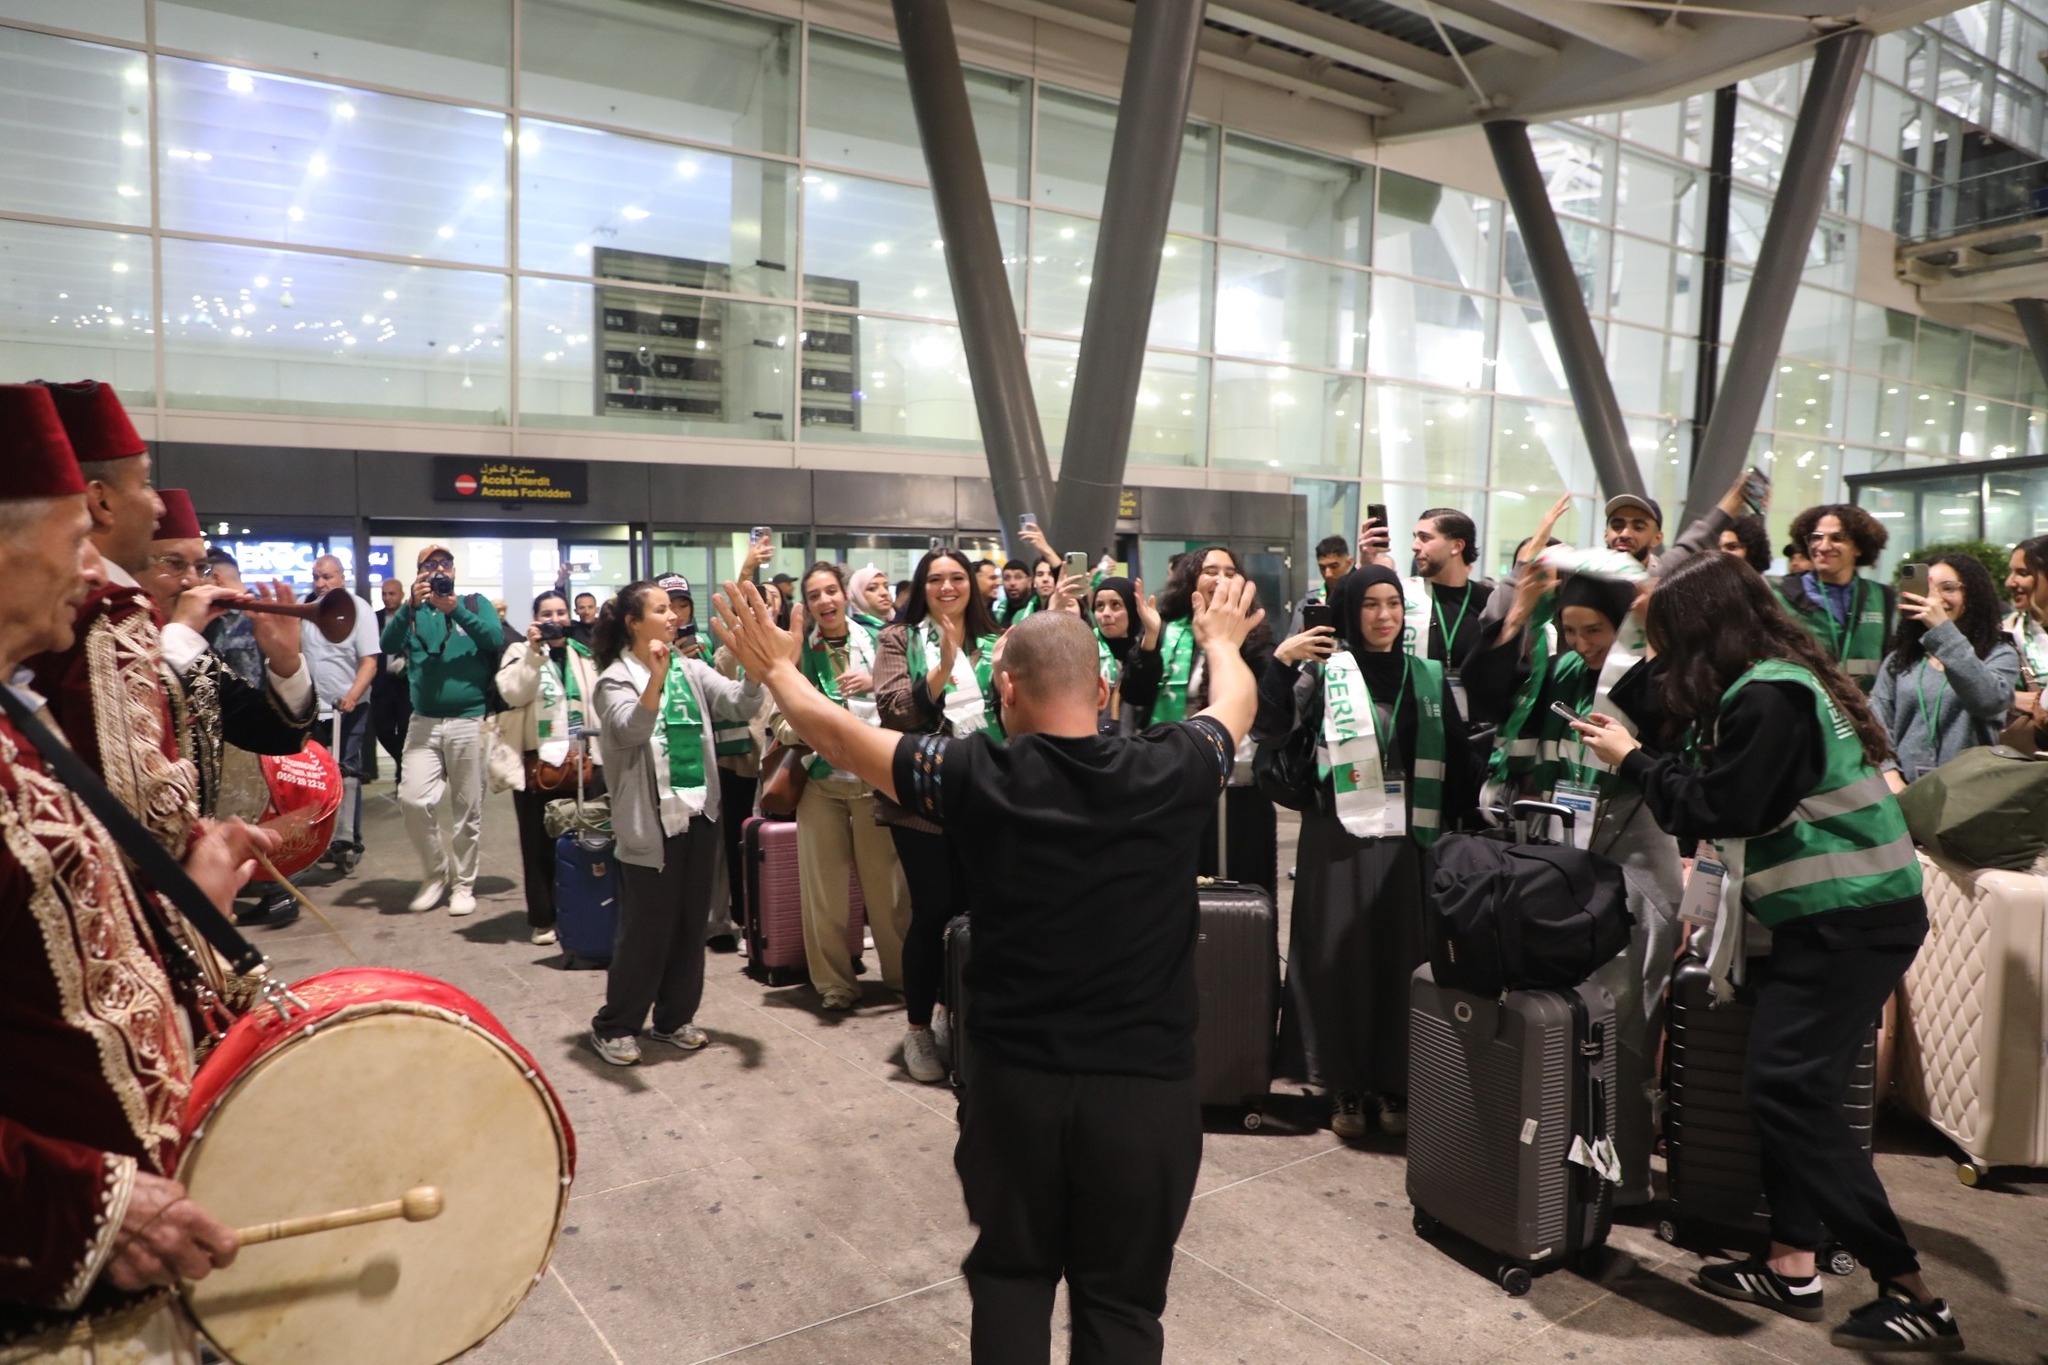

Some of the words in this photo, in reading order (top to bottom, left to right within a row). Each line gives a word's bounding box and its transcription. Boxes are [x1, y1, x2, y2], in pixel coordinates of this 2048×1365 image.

[480, 475, 513, 485] Accès
[514, 476, 550, 487] Interdit
[481, 487, 519, 497] Access
[520, 488, 572, 499] Forbidden
